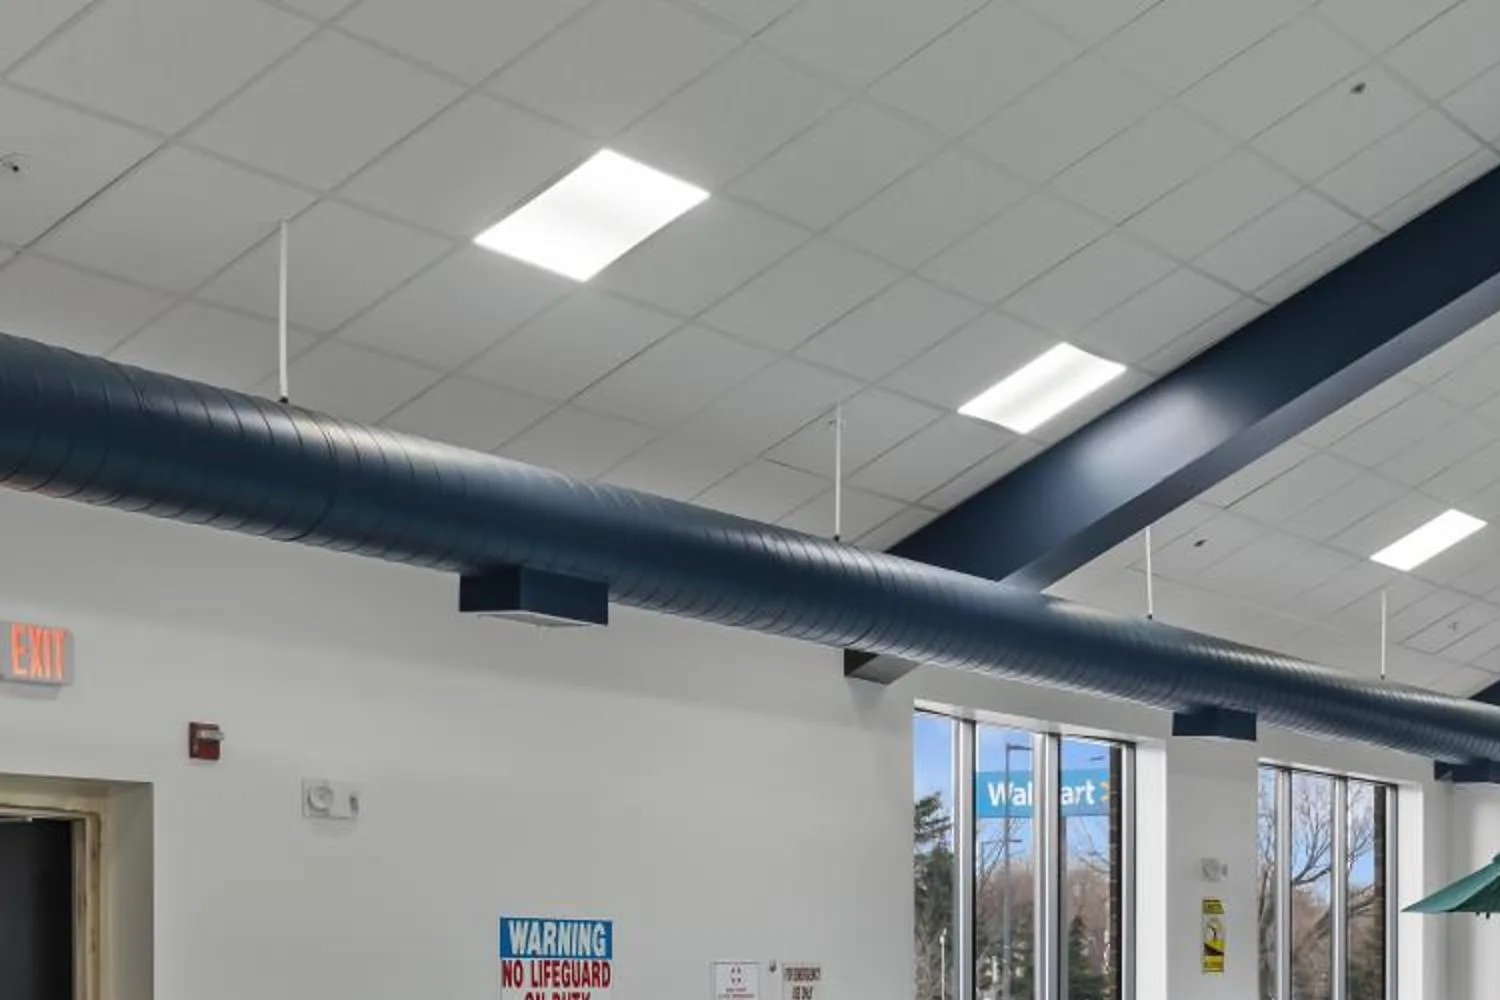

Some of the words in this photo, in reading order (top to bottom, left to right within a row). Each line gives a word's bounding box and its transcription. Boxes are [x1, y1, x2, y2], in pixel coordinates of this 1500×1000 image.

[11, 622, 65, 679] EXIT
[986, 779, 1096, 807] Walart
[508, 920, 606, 957] WARNING
[502, 960, 523, 988] NO
[531, 960, 611, 988] LIFEGUARD
